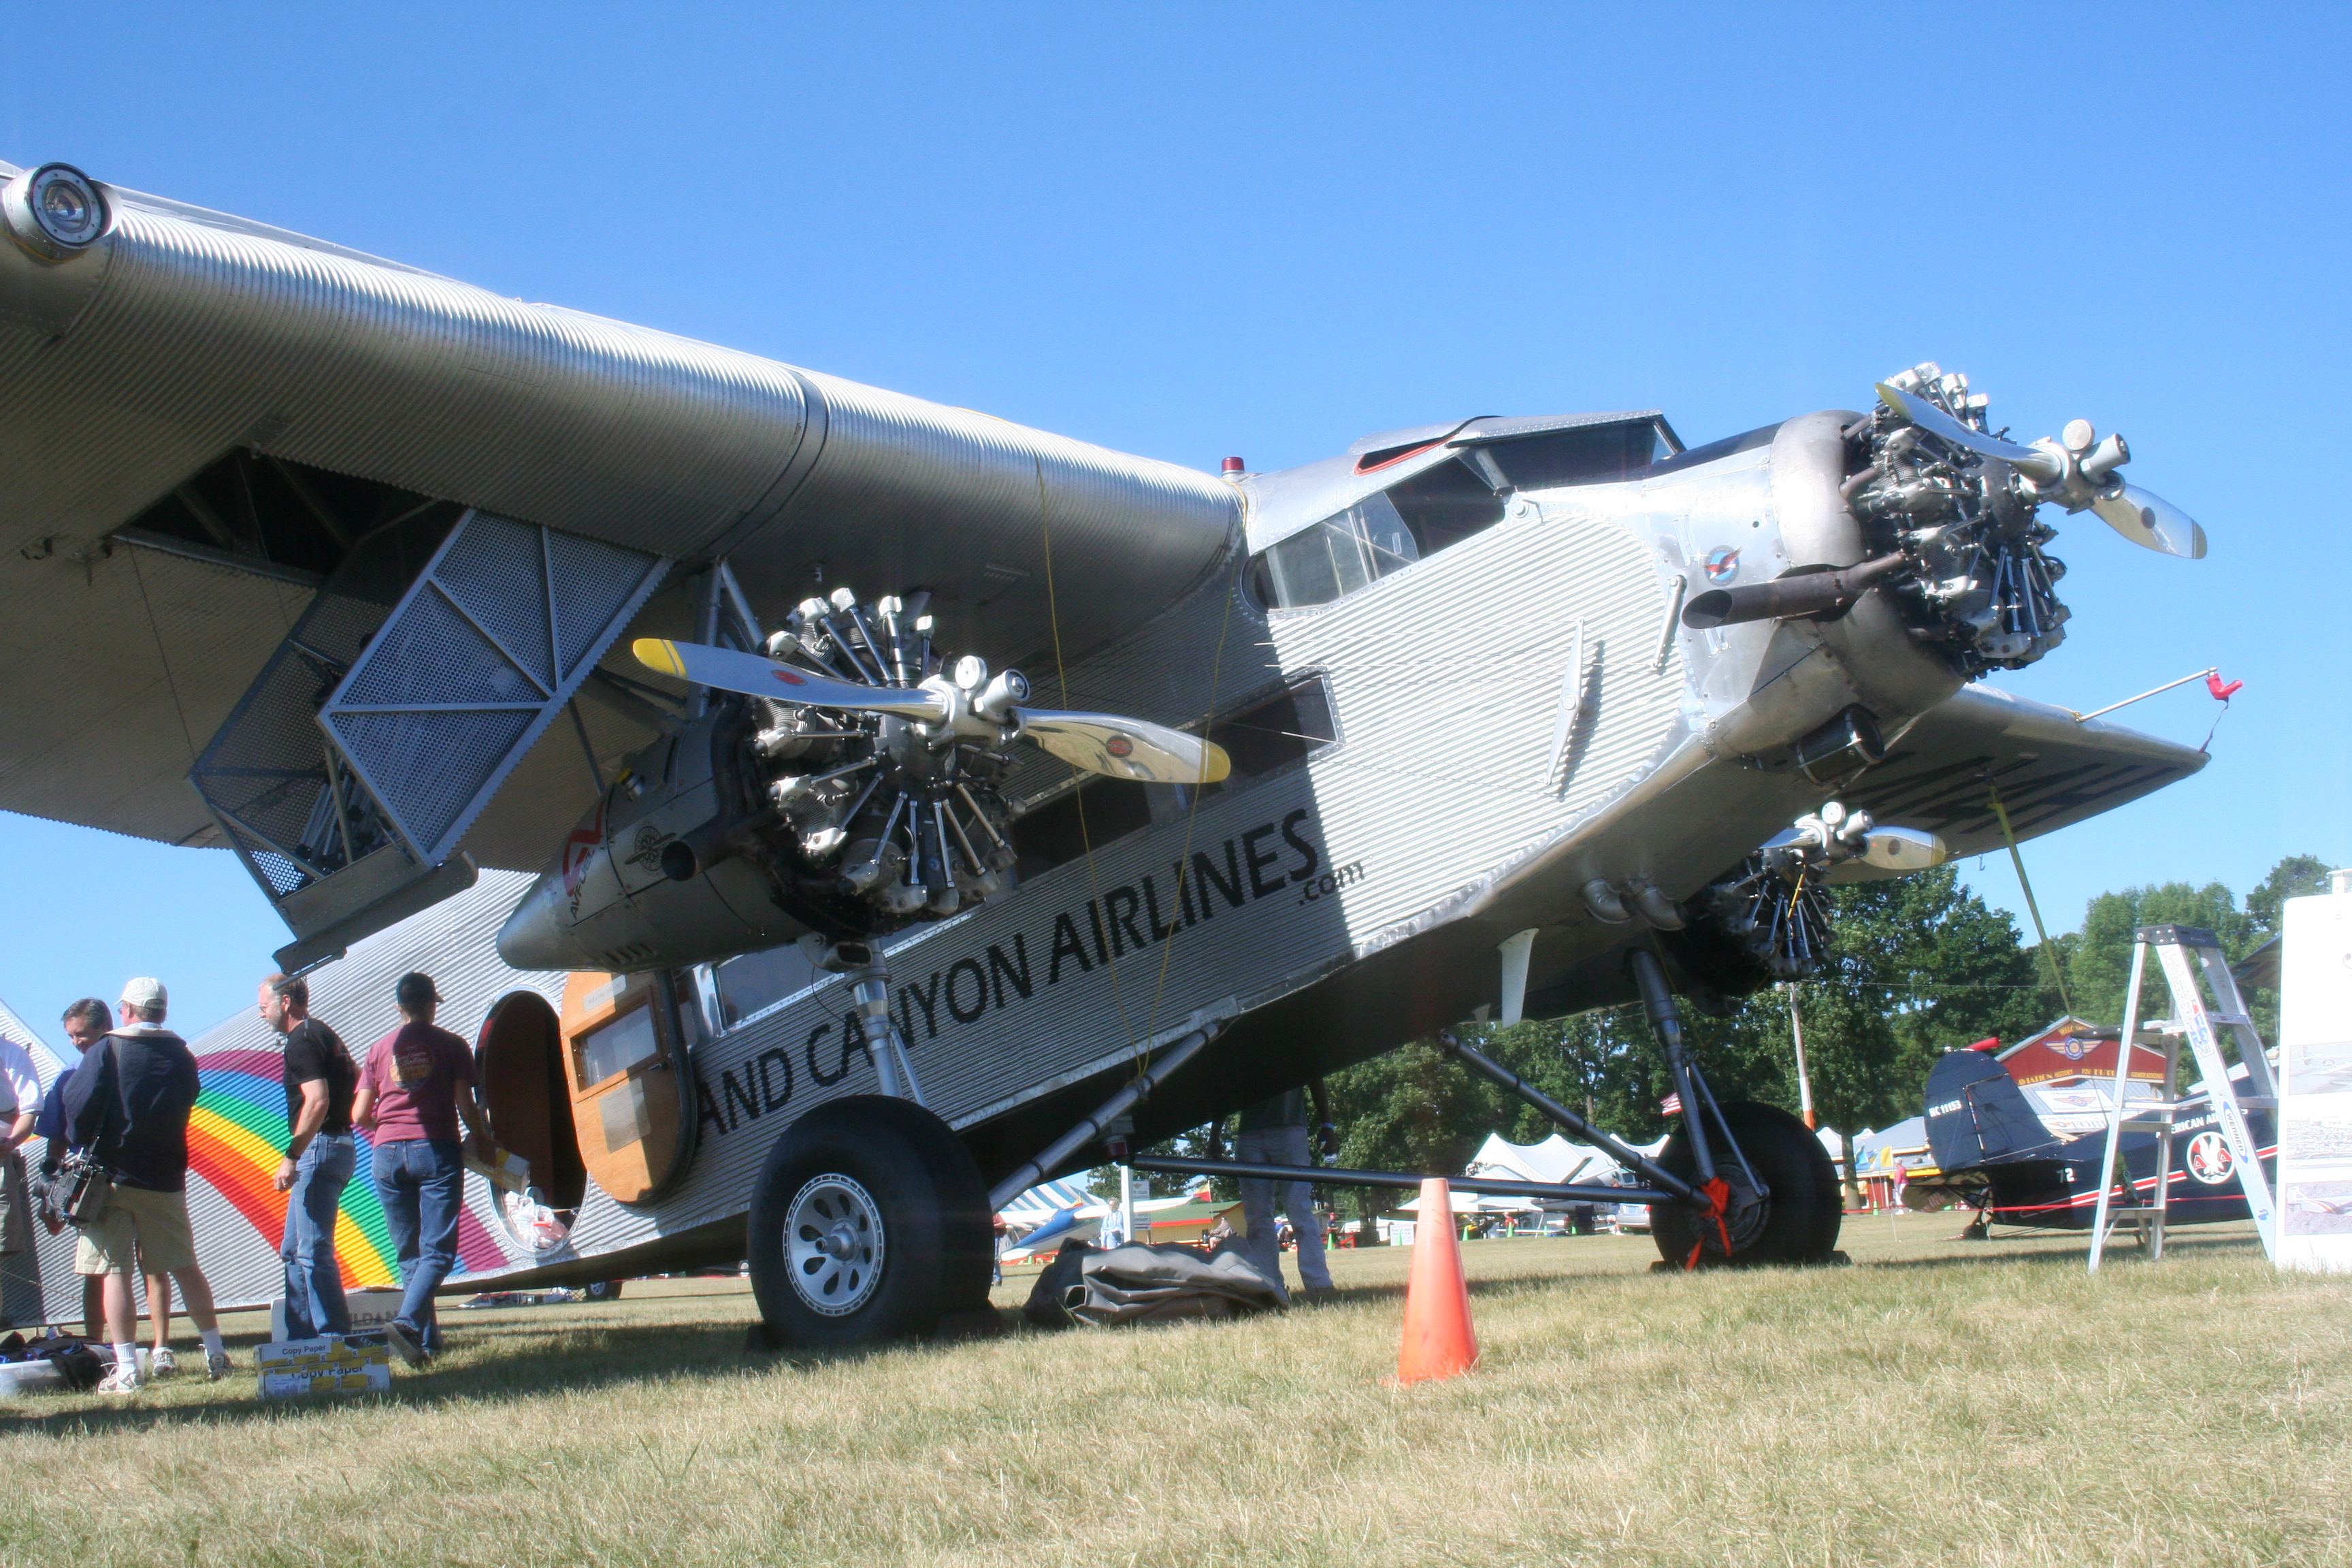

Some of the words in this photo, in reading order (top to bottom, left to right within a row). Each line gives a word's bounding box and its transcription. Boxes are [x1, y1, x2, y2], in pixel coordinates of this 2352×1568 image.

[1298, 862, 1365, 906] .com
[806, 933, 1033, 1086] CANYON
[1048, 808, 1318, 985] AIRLINES
[2226, 1113, 2244, 1152] WERNER
[2057, 1167, 2074, 1183] 72
[282, 1347, 302, 1355] Copy
[304, 1345, 326, 1353] Paper
